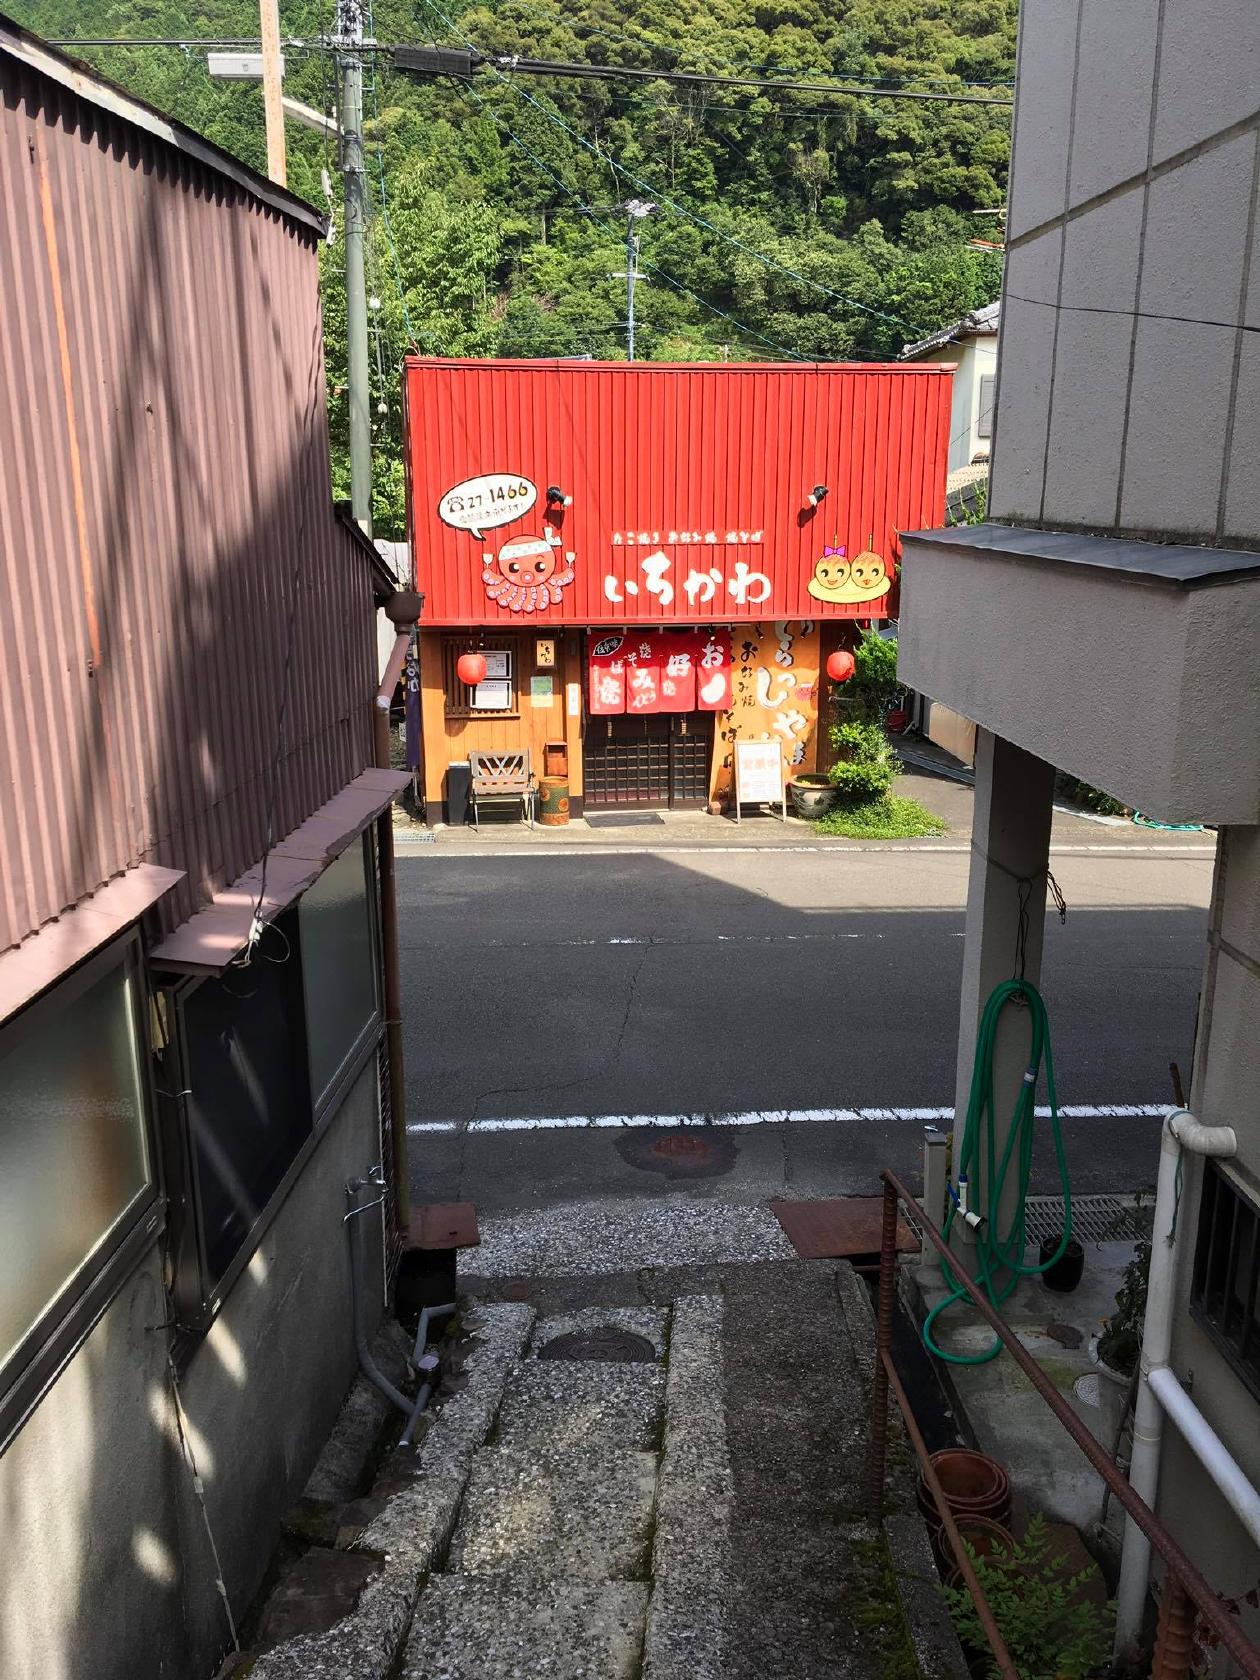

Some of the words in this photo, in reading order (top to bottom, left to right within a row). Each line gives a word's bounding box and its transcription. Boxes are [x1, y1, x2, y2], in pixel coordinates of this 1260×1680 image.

[490, 482, 528, 502] 1466
[604, 551, 771, 605] いちかわ
[540, 642, 552, 664] いちかわ
